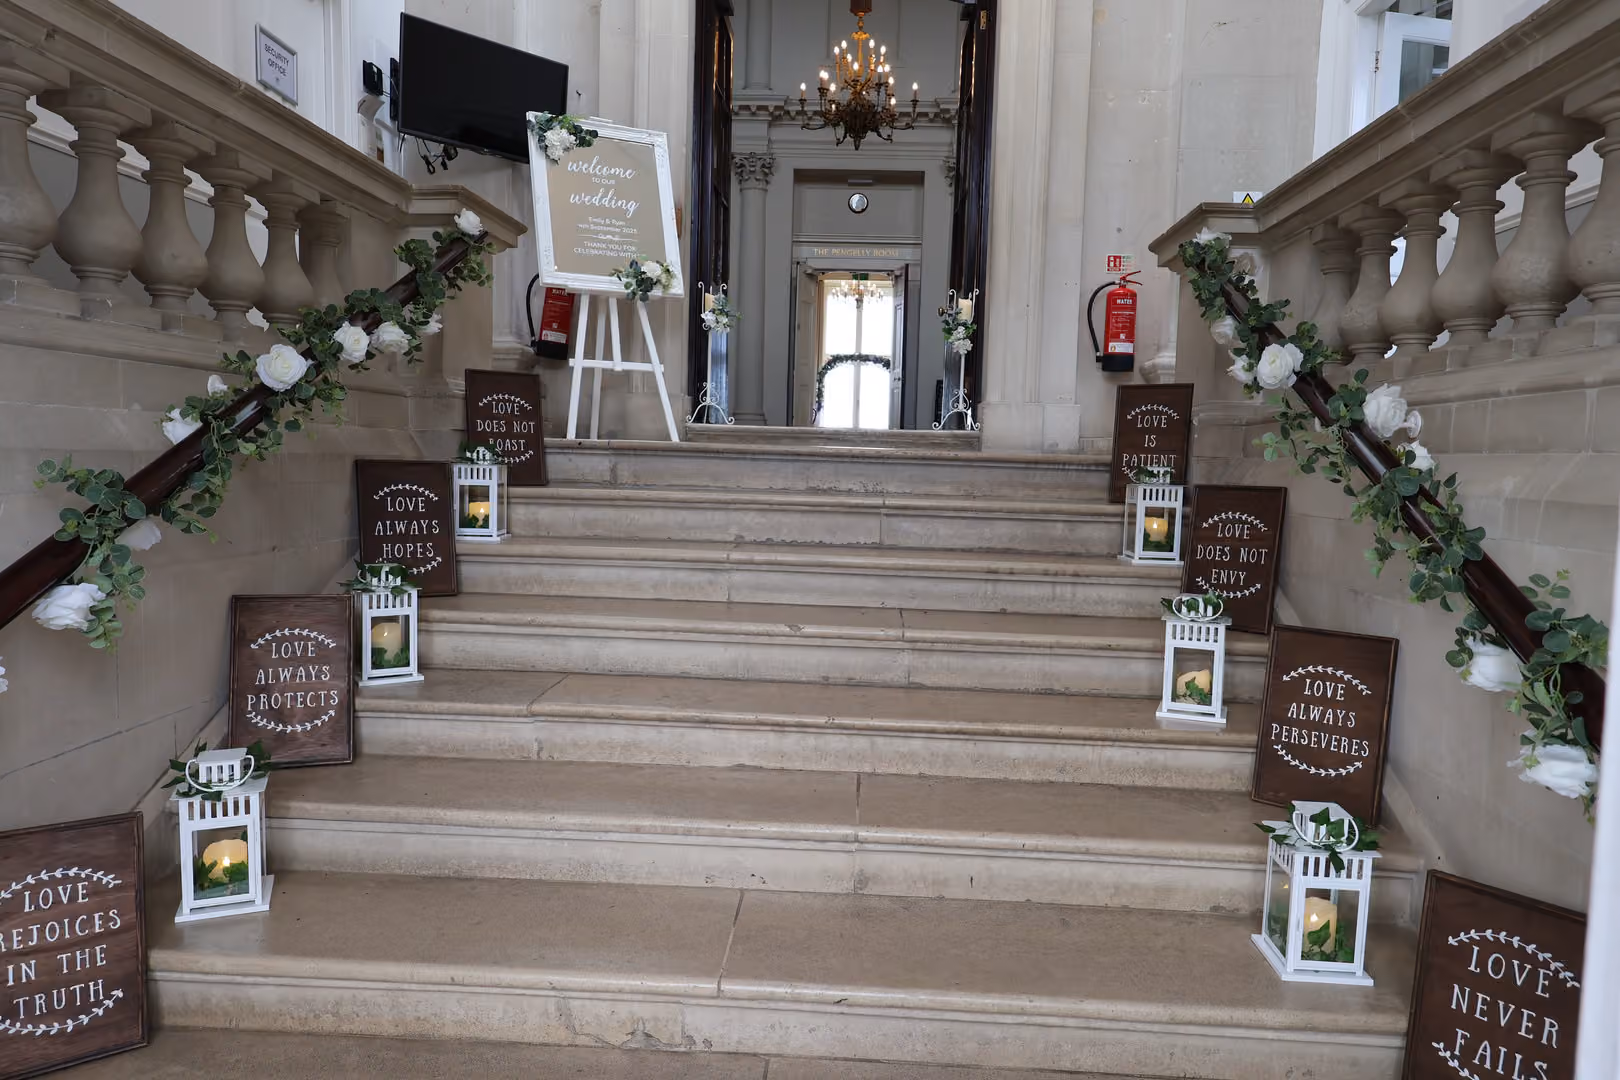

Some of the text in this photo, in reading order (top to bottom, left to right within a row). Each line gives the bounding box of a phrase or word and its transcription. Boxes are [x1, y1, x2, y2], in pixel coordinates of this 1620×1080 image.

[264, 44, 289, 66] SECURITY
[268, 58, 287, 76] OFFICE
[568, 156, 636, 178] welcome
[570, 188, 640, 218] wedding
[574, 248, 619, 256] CELEBRATING
[584, 241, 607, 249] THANK
[814, 248, 828, 256] THE
[874, 248, 898, 256] ROOM
[492, 402, 520, 414] LOVE
[476, 420, 535, 434] DOES NOT
[1137, 415, 1168, 428] LOVE
[1144, 434, 1156, 448] IS
[1122, 454, 1176, 467] PATIENT
[387, 497, 426, 512] LOVE
[375, 520, 440, 536] ALWAYS
[1218, 522, 1250, 539] LOVE
[383, 542, 434, 558] HOPES
[1196, 544, 1268, 564] DOES NOT
[1211, 568, 1246, 586] ENVY
[272, 642, 316, 658] LOVE
[256, 665, 330, 684] ALWAYS
[1304, 678, 1346, 700] LOVE
[247, 690, 338, 710] PROTECTS
[1288, 702, 1356, 728] ALWAYS
[1272, 723, 1369, 756] PERSEVERES
[24, 882, 89, 912] LOVE
[6, 944, 108, 986] IN THE
[1468, 945, 1552, 998] LOVE
[13, 980, 104, 1019] TRUTH
[1451, 984, 1559, 1048] NEVER
[1455, 1028, 1548, 1080] FAILS
